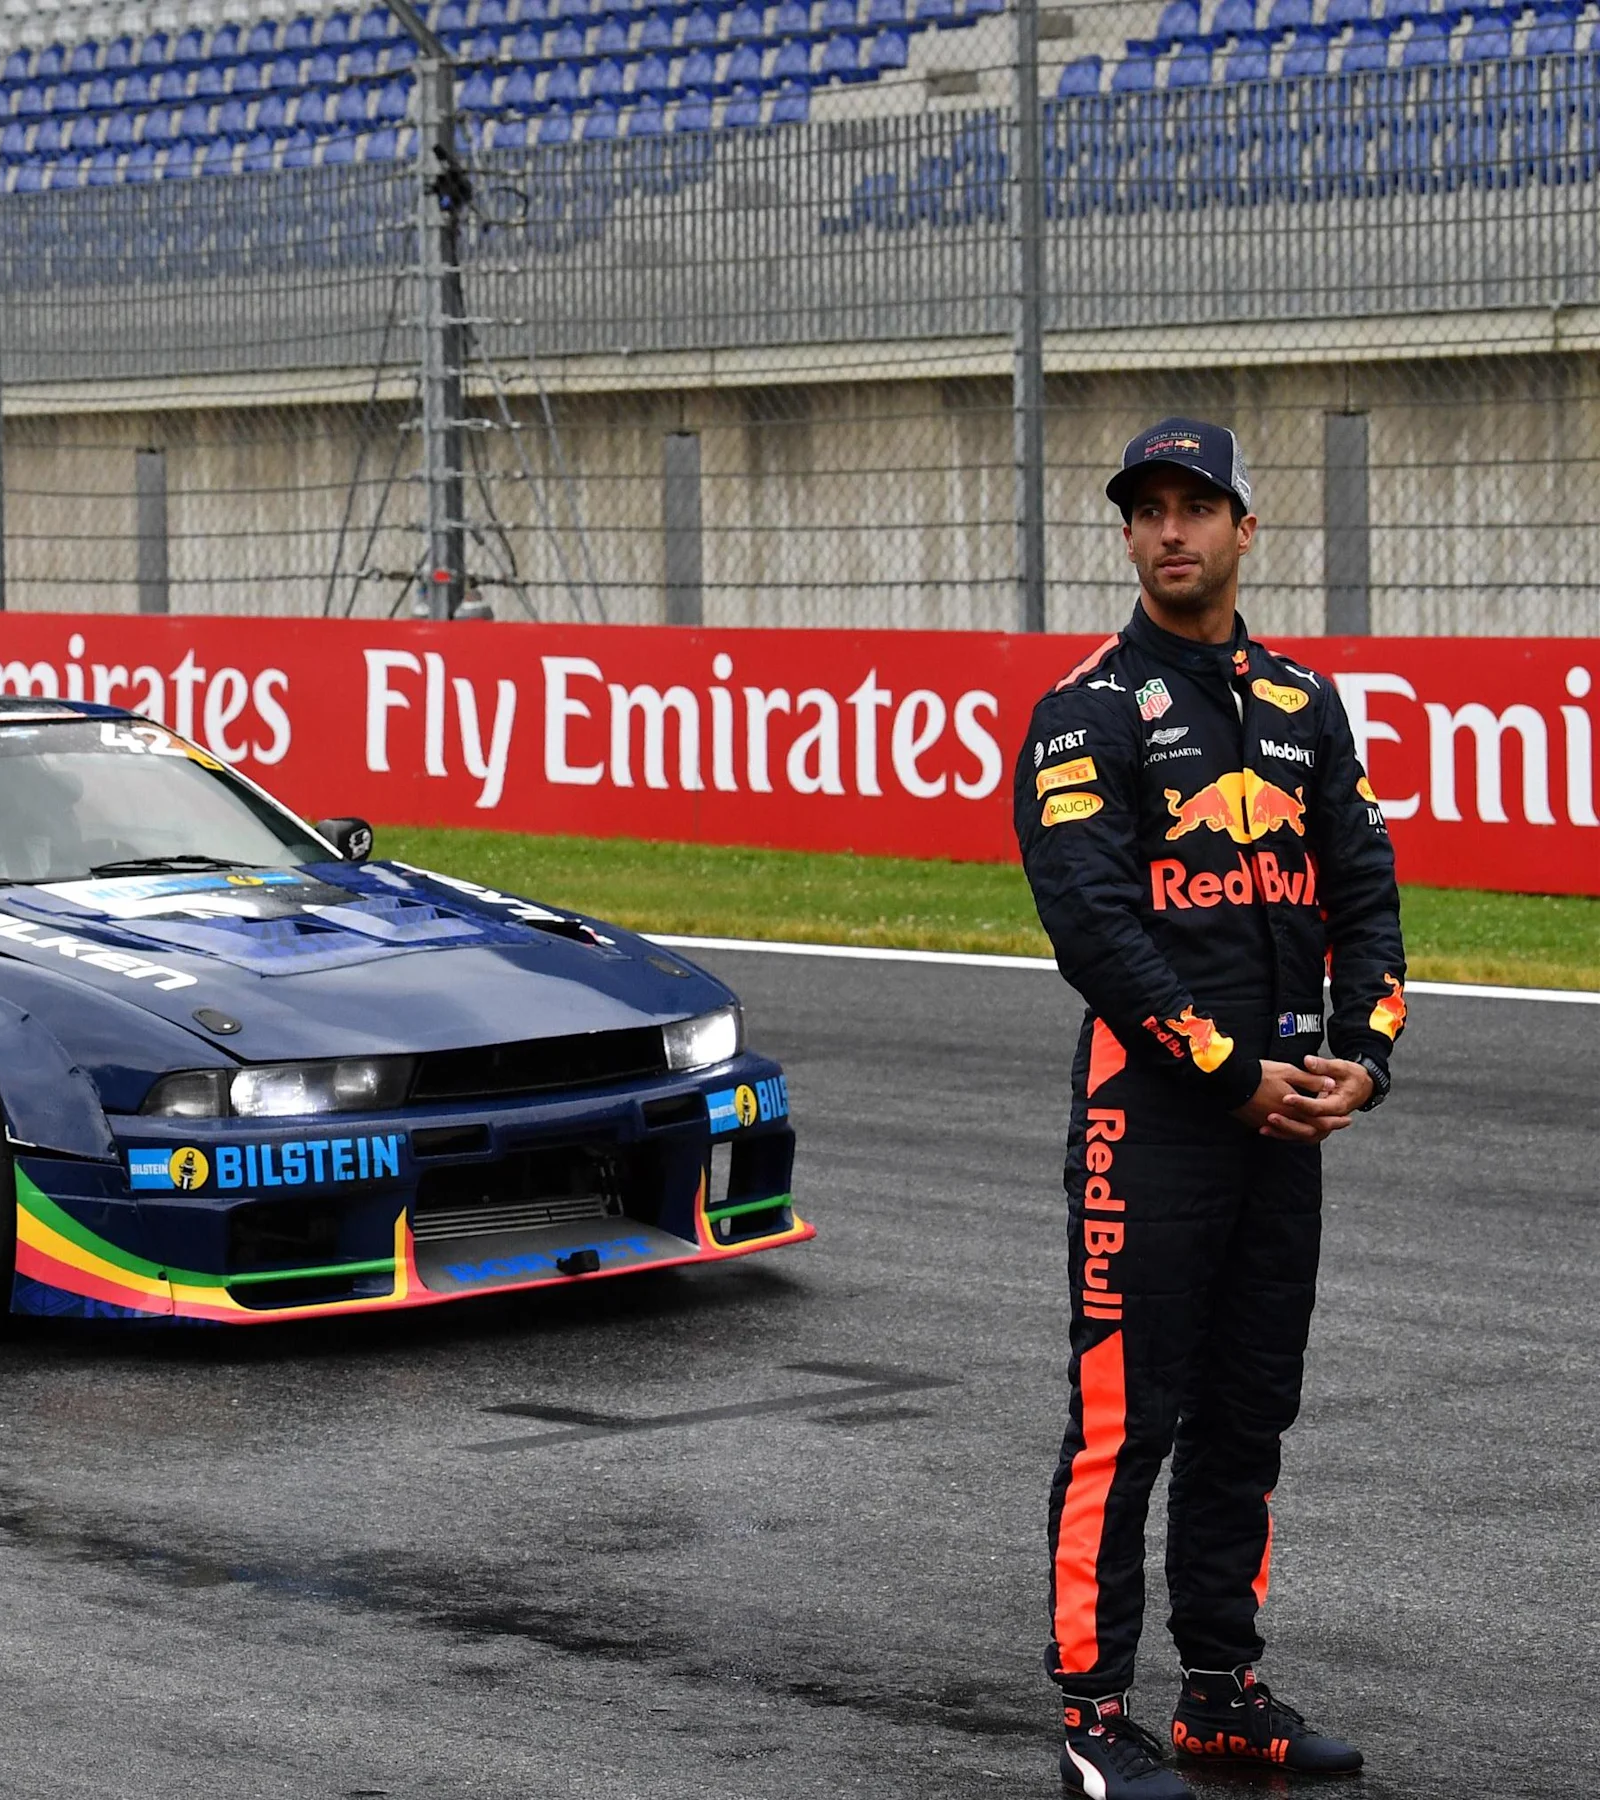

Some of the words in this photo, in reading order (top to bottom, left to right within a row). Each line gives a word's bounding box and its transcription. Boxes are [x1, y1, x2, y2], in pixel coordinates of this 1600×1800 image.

[1170, 431, 1201, 440] MARTIN
[1136, 681, 1165, 706] TAG
[100, 722, 189, 757] 42
[363, 649, 517, 808] Fly
[541, 652, 1003, 800] Emirates
[1048, 730, 1088, 756] AT&T
[1143, 751, 1168, 769] ATON
[1168, 747, 1202, 760] MARTIN
[1050, 798, 1094, 816] RAUCH
[1150, 851, 1252, 911] Red
[1142, 1015, 1173, 1043] Red
[131, 1163, 168, 1176] BILSTEIN
[215, 1134, 400, 1189] BILSTEIN
[1084, 1108, 1126, 1212] Red
[1083, 1219, 1125, 1320] Bull
[1064, 1708, 1081, 1727] 3
[1172, 1720, 1224, 1754] Red
